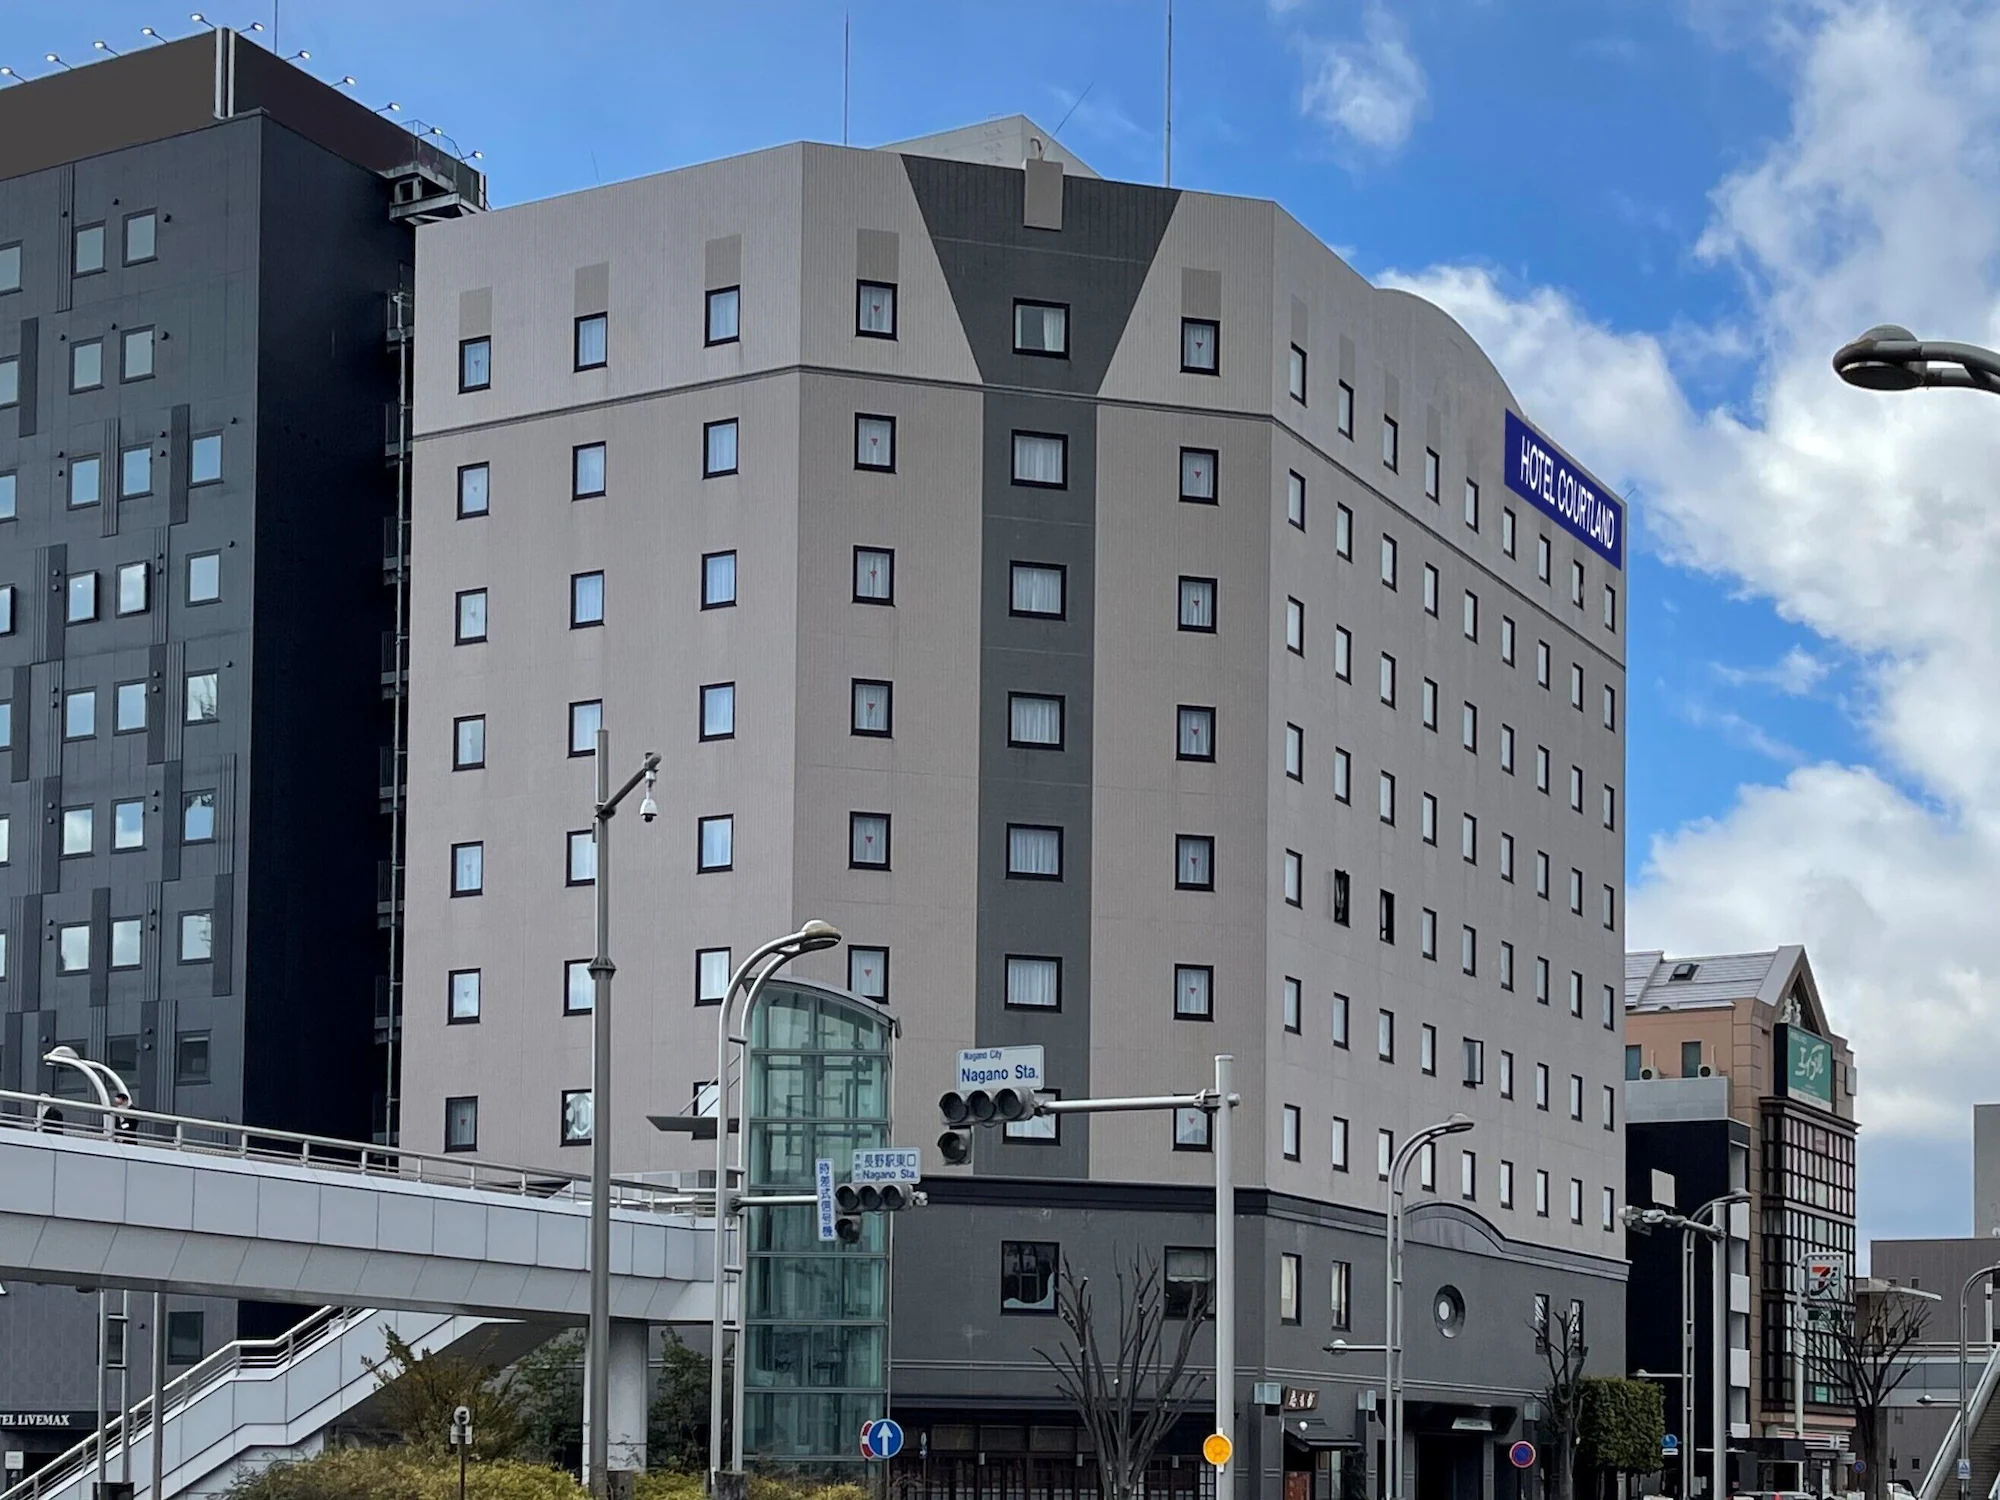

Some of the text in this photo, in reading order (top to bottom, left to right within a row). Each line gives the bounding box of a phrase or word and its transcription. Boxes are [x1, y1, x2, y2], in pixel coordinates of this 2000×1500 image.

[1520, 435, 1615, 550] HOTEL COURTLAND
[963, 1049, 1002, 1062] Nagano City
[961, 1064, 1039, 1084] Nagano Sta.
[864, 1153, 916, 1168] 長野駅東口
[863, 1170, 896, 1181] Nagano
